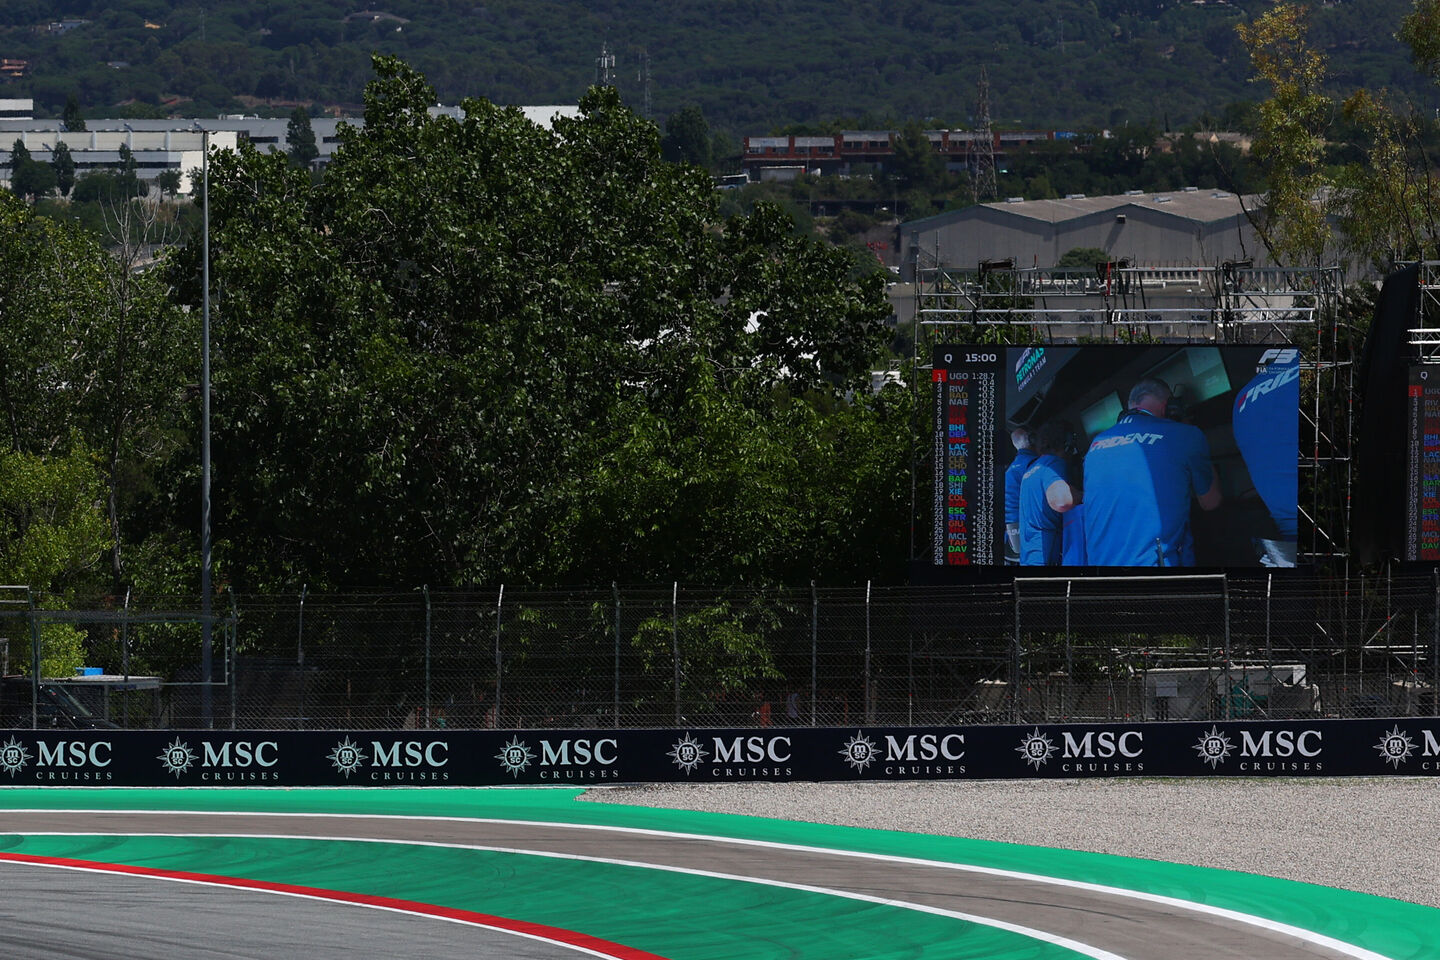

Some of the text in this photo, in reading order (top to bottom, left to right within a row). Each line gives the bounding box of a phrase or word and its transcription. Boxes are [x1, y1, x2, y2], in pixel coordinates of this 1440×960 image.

[944, 353, 997, 364] Q 15:00
[1258, 349, 1298, 364] F3
[1090, 432, 1164, 452] TRIDENT
[36, 741, 111, 767] MSC
[202, 742, 278, 767] MSC
[370, 742, 448, 766] MSC
[540, 739, 617, 765] MSC
[712, 737, 791, 762] MSC
[884, 734, 964, 760] MSC
[1062, 732, 1142, 758] MSC
[1240, 731, 1321, 756] MSC
[713, 768, 791, 776] CRUISES
[885, 766, 965, 774] CRUISES
[1062, 763, 1143, 771] CRUISES
